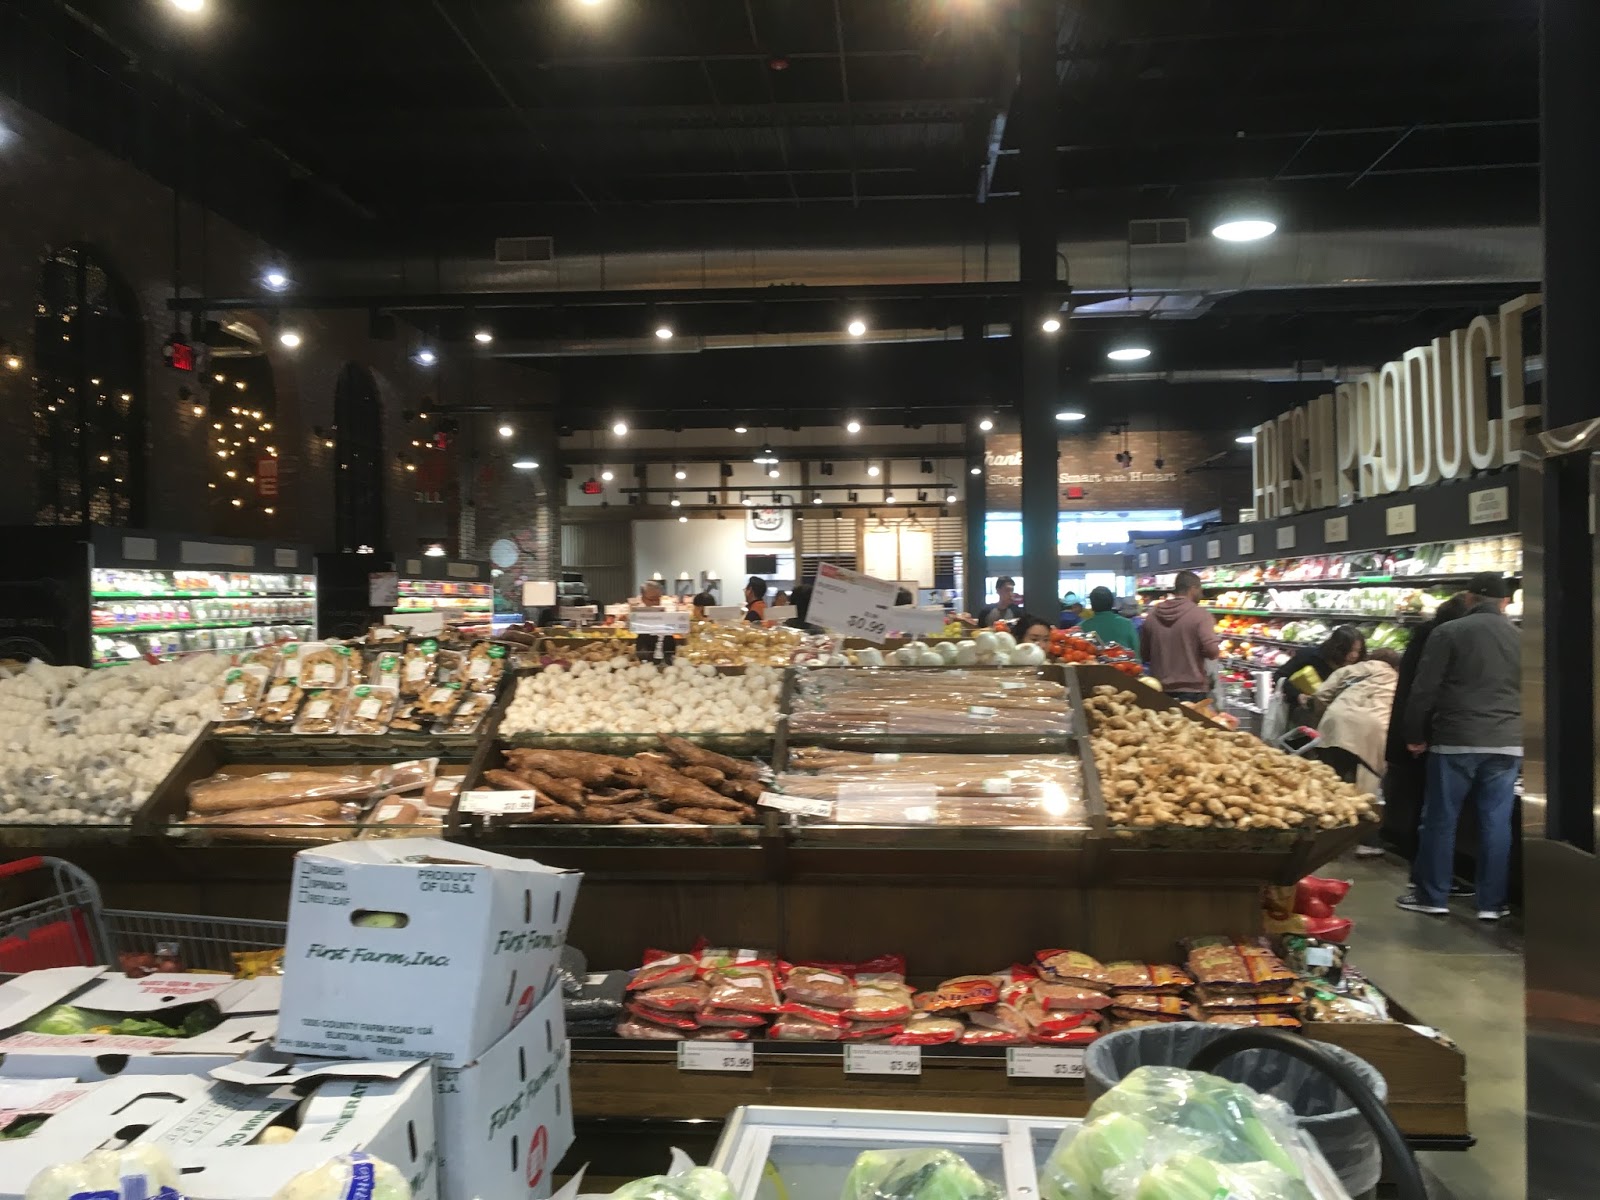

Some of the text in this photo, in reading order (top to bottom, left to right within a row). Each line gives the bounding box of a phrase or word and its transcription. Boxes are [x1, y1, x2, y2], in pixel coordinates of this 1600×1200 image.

[1252, 292, 1544, 522] FRESH PRODUCE
[984, 451, 1022, 466] hank
[1059, 473, 1101, 484] Smart
[1129, 471, 1178, 483] Hmart
[418, 869, 477, 882] PRODUCT
[420, 881, 475, 894] OF U.S.A.
[305, 944, 350, 962] First
